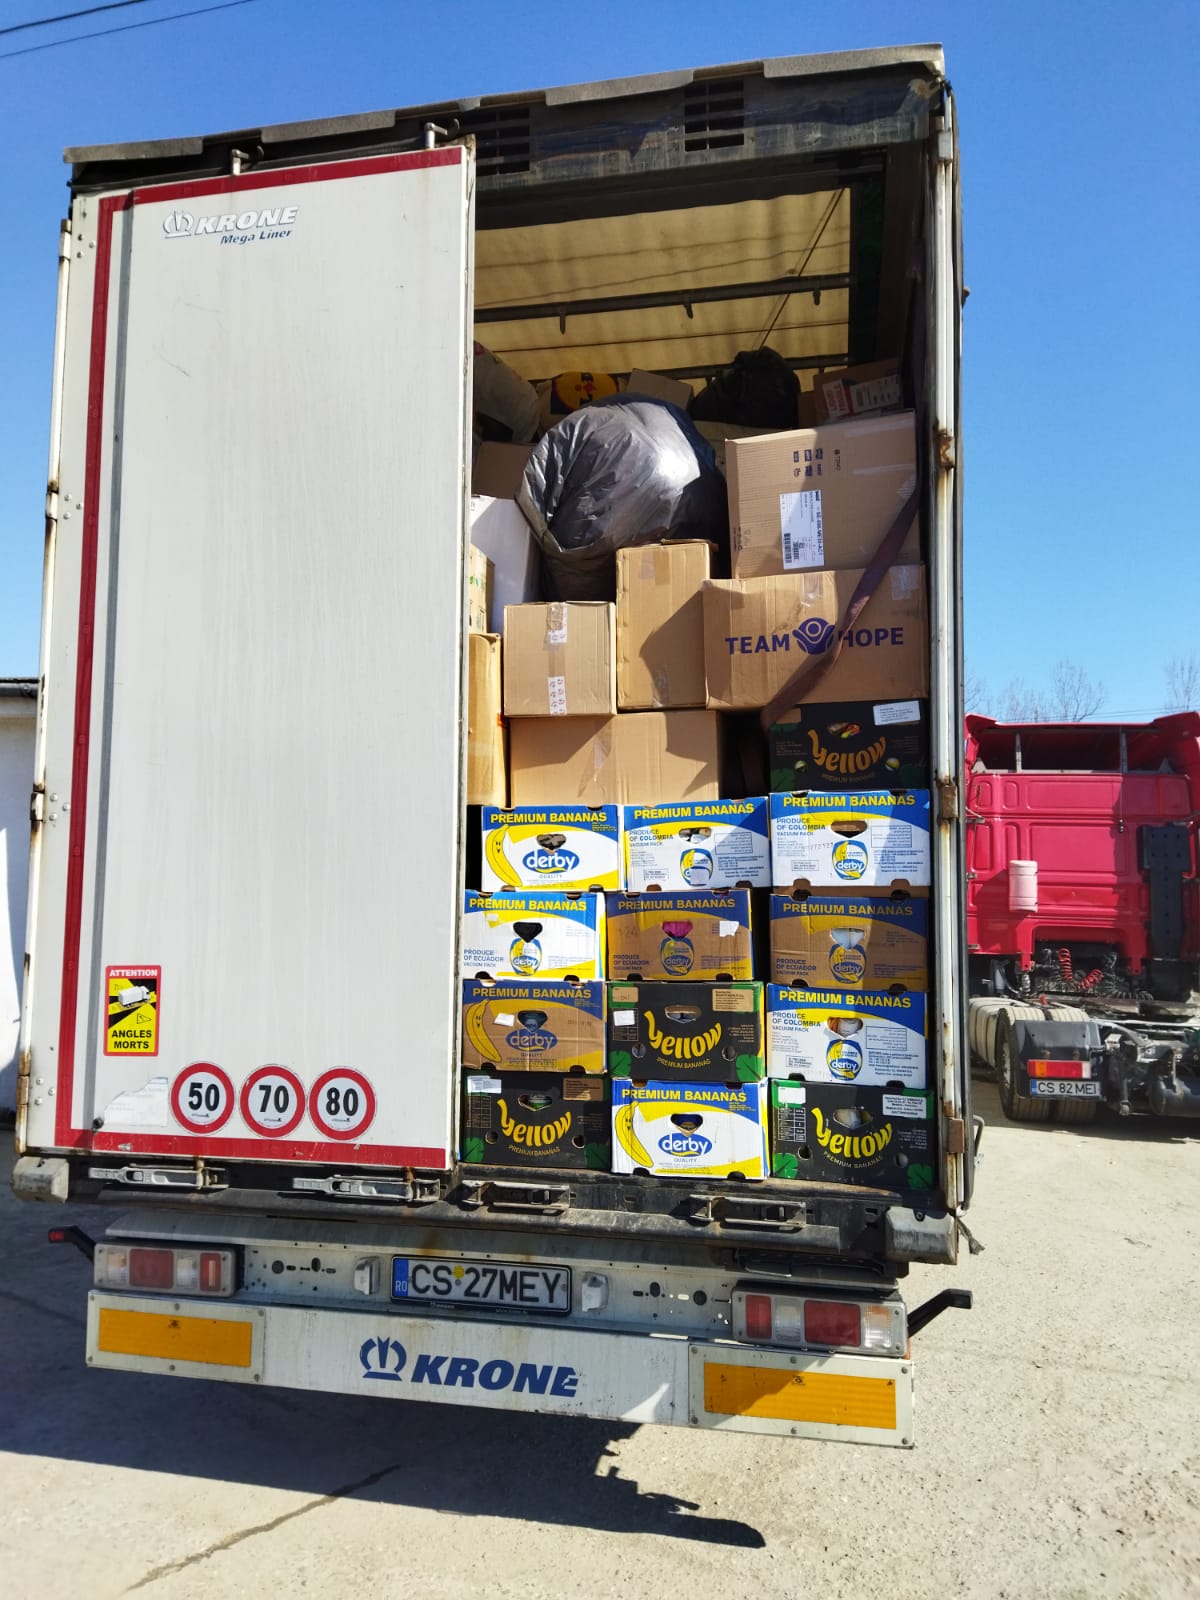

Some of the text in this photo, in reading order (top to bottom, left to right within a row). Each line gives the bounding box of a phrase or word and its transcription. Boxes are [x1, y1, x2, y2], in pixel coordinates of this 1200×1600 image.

[194, 206, 299, 235] KRONE
[220, 229, 292, 245] Mega Liner
[725, 627, 904, 655] TEAM HOPE
[783, 795, 915, 807] PREMIUM BANANAS
[490, 812, 607, 823] PREMIUM BANANAS
[634, 803, 754, 820] PREMIUM BANANAS
[639, 834, 674, 842] COLOMBIA
[526, 851, 576, 871] derby
[836, 859, 865, 871] derby
[469, 899, 587, 911] PREMIUM BANANAS
[618, 899, 736, 910] PREMIUM BANANAS
[783, 904, 913, 916] PREMIUM BANANAS
[514, 957, 537, 968] derby
[665, 957, 690, 967] derby
[109, 969, 158, 977] ATTENTION
[834, 963, 863, 974] derby
[473, 987, 591, 999] PREMIUM BANANAS
[780, 991, 911, 1008] PREMIUM BANANAS
[783, 1019, 821, 1027] COLOMBIA
[112, 1030, 152, 1039] ANGLES
[509, 1031, 554, 1049] derby
[113, 1040, 149, 1049] MORTS
[832, 1059, 859, 1071] derby
[1038, 1082, 1096, 1094] CS 82 MEI
[188, 1082, 220, 1111] 50
[259, 1084, 290, 1113] 70
[326, 1087, 359, 1116] 80
[622, 1090, 747, 1102] PREMIUM BANANAS
[662, 1136, 709, 1154] derby
[412, 1263, 452, 1295] CS
[395, 1280, 408, 1292] RO
[411, 1354, 579, 1398] KRONE
